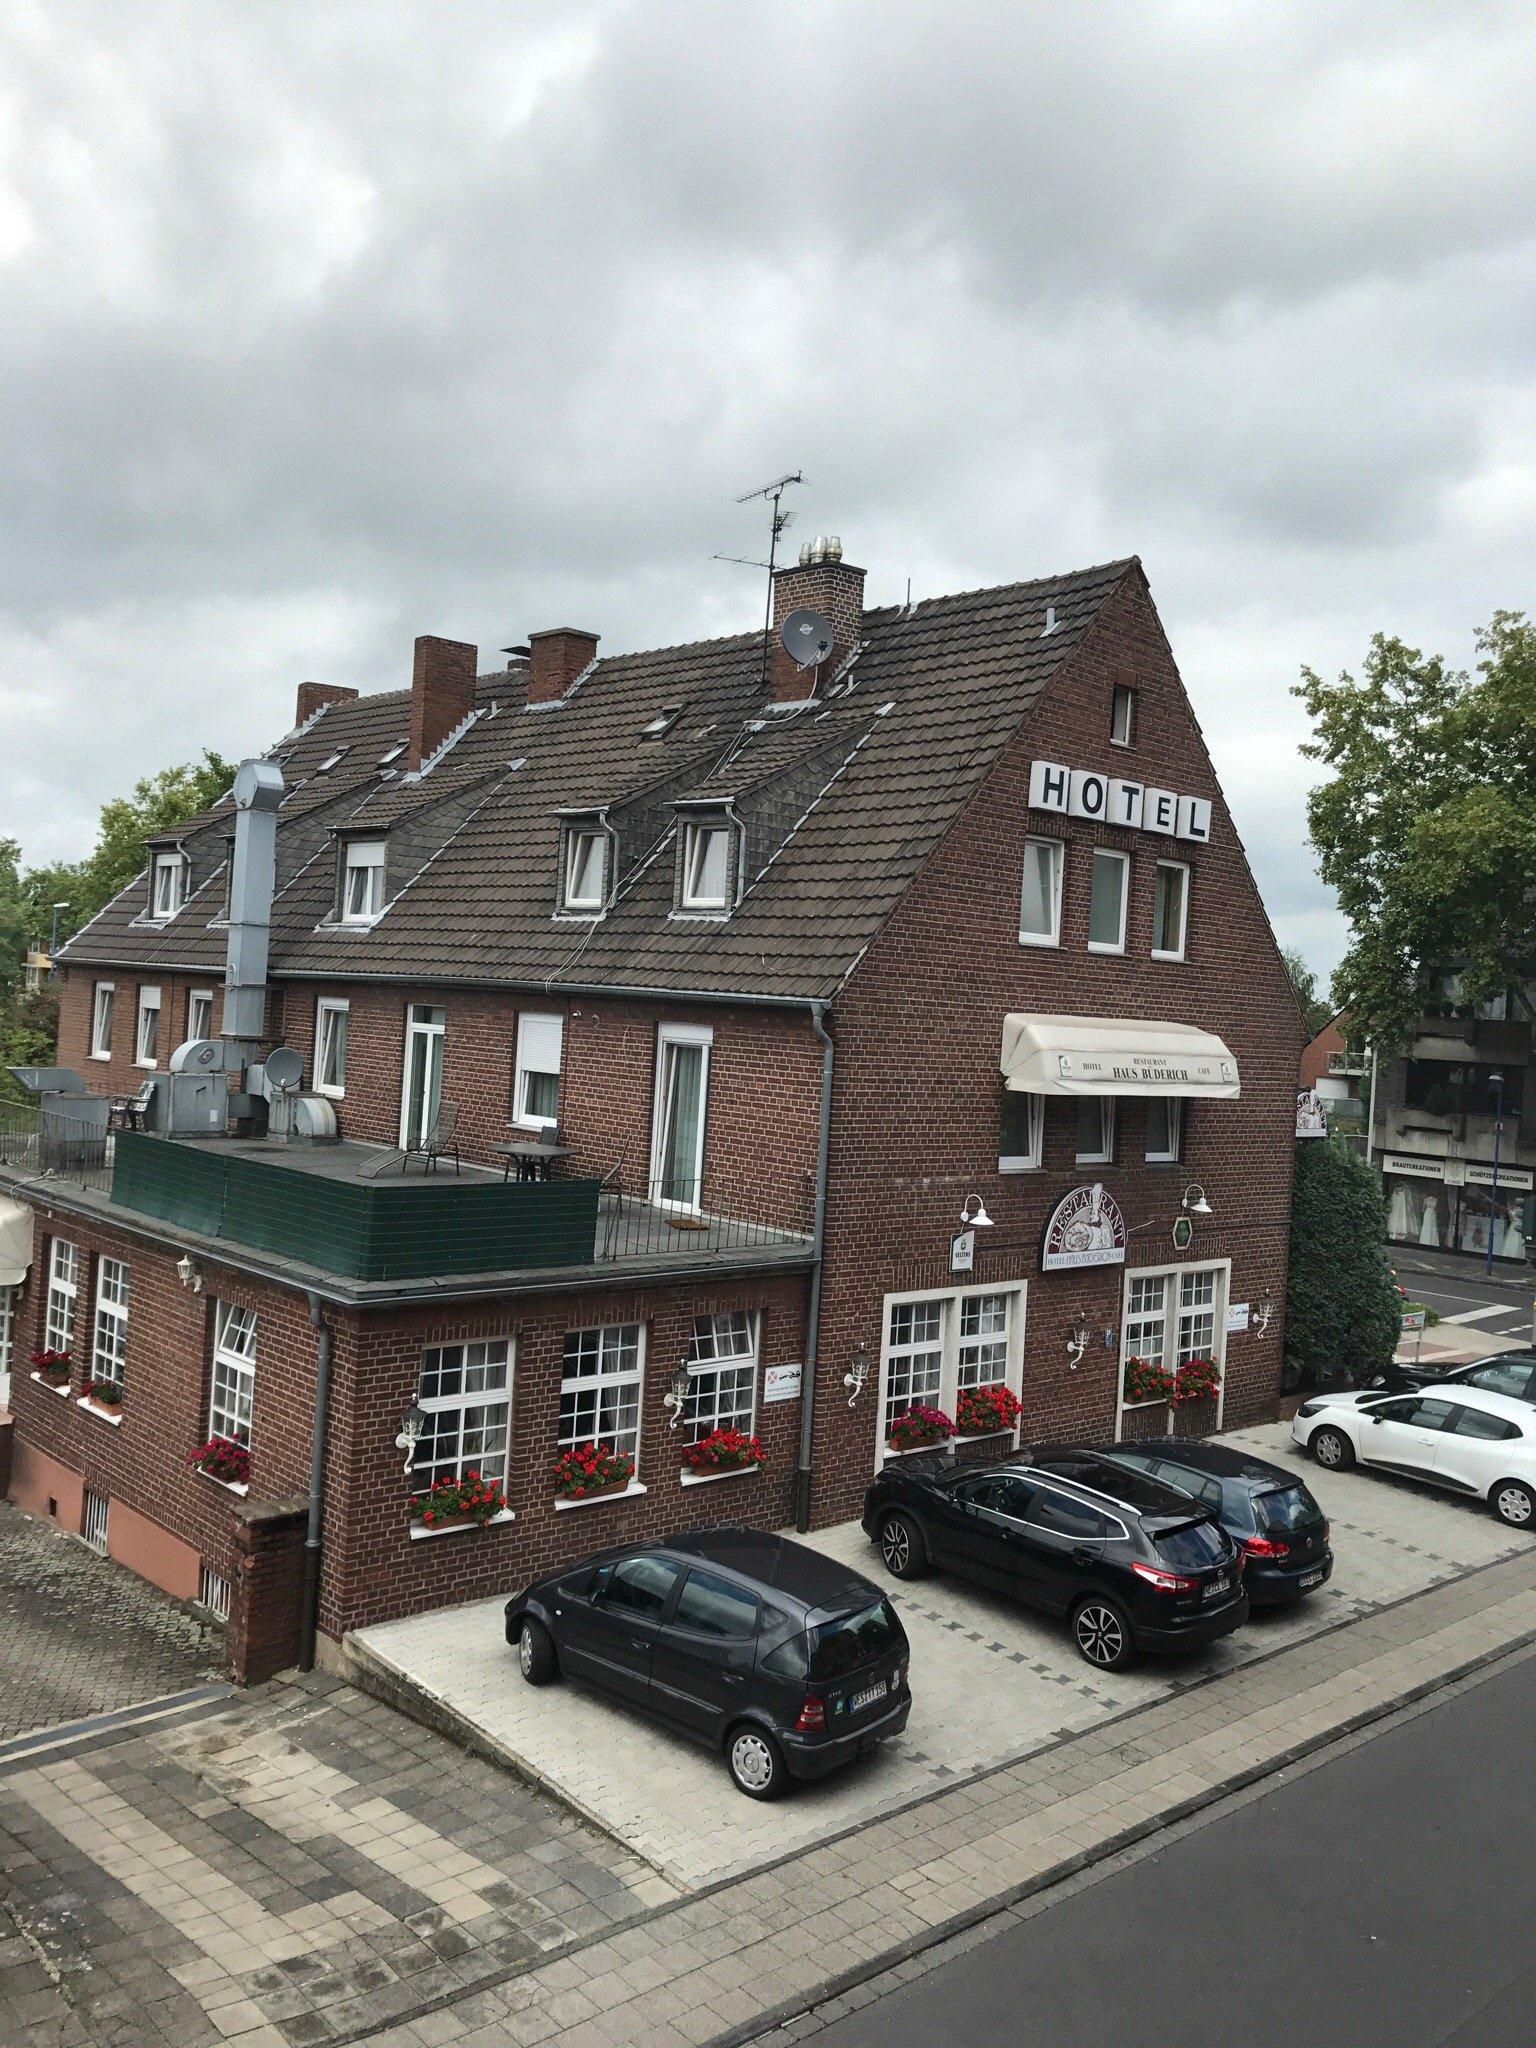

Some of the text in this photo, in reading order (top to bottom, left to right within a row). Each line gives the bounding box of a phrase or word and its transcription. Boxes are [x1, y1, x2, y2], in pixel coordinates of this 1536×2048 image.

[1042, 767, 1206, 838] HOTEL
[1082, 1062, 1103, 1071] HOTEL
[1133, 1057, 1167, 1067] RESTAURANT
[1113, 1067, 1139, 1080] HAUS
[1392, 1161, 1441, 1173] BRAUTCREATIONEN
